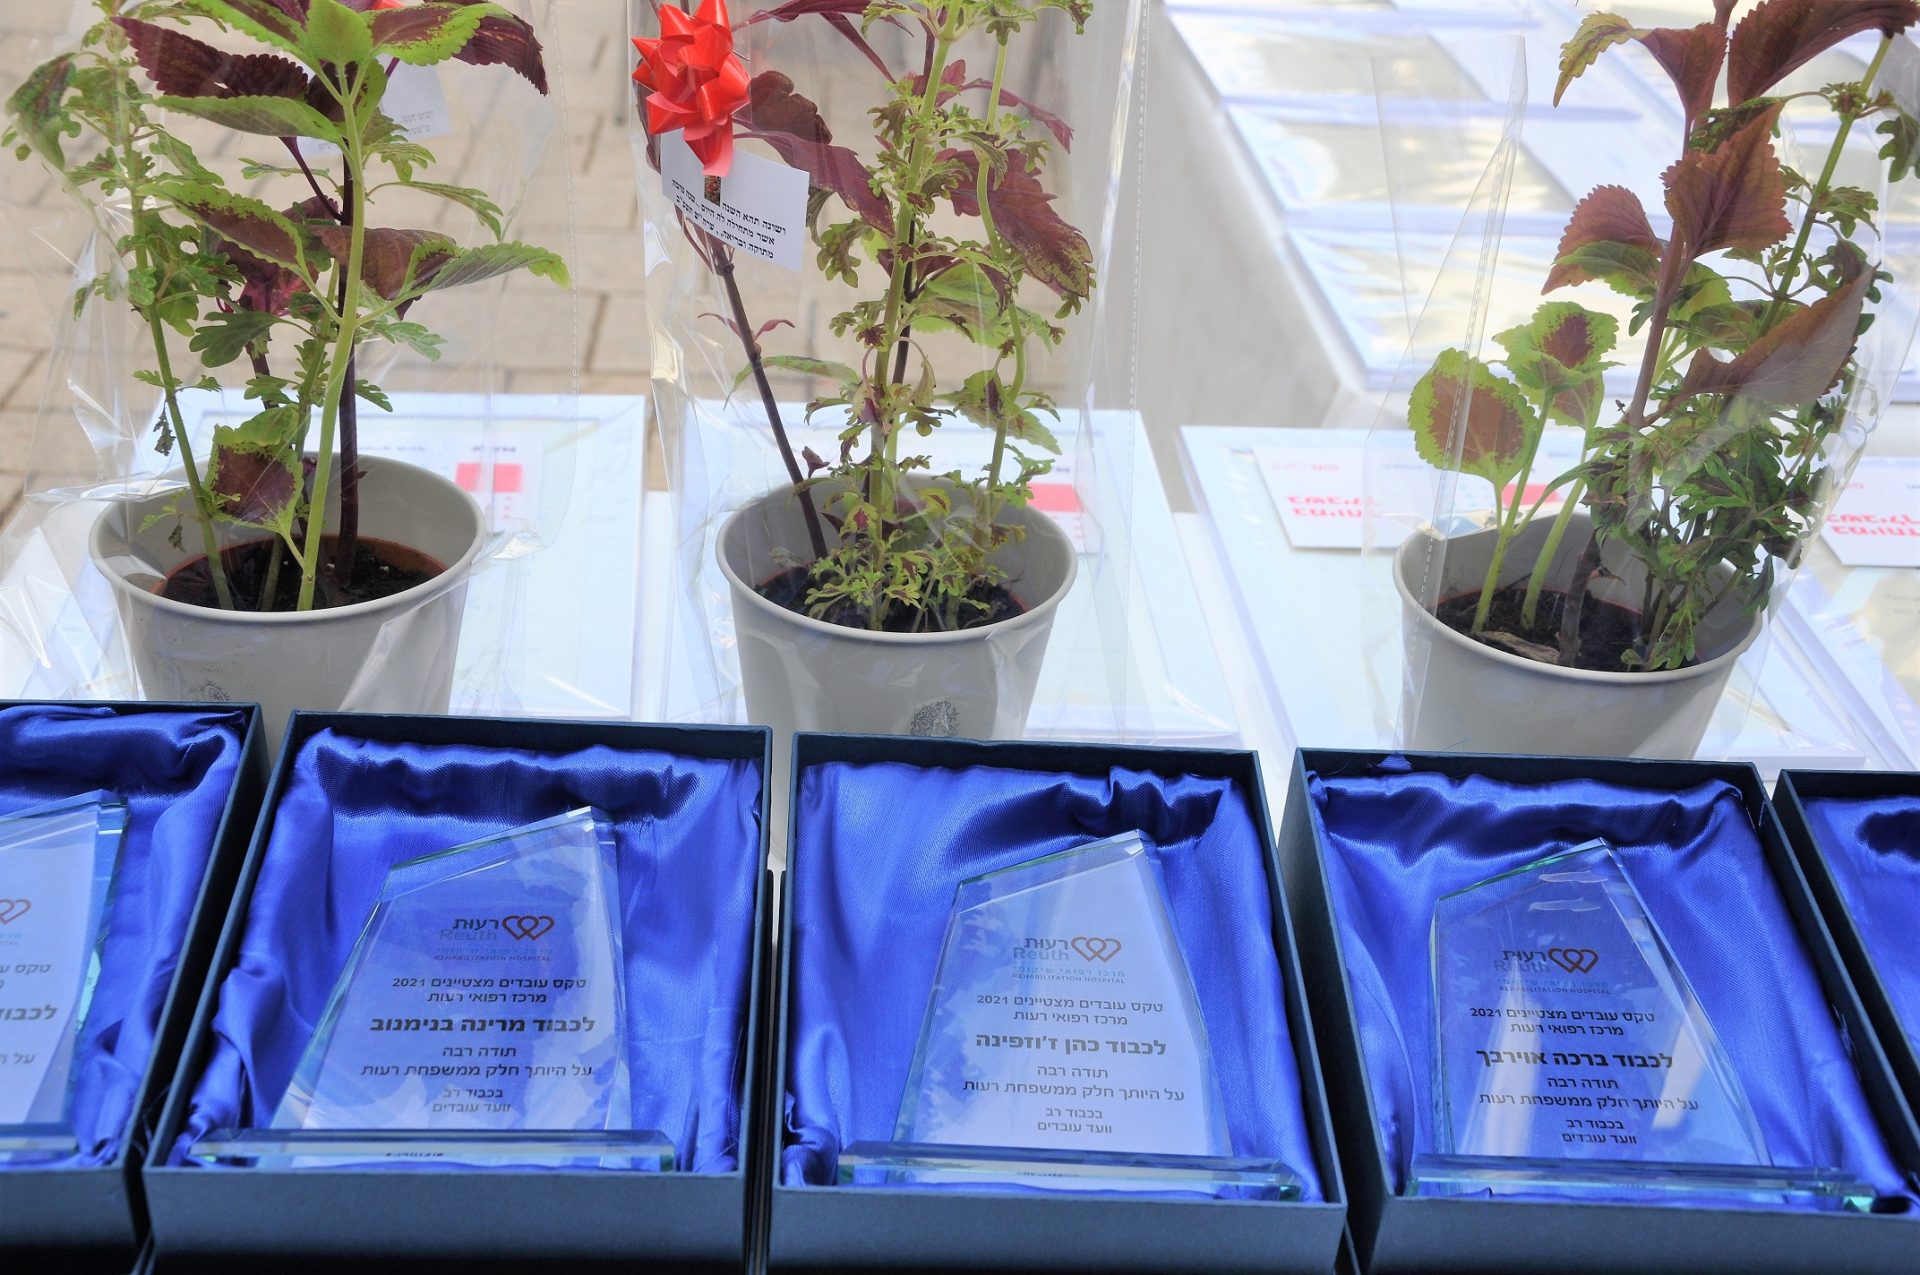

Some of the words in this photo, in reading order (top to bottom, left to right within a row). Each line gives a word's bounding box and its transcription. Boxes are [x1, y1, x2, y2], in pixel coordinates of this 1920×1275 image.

[722, 202, 741, 218] השנה
[716, 212, 725, 223] לה
[742, 213, 760, 226] תהא
[726, 218, 754, 238] מתחילה
[756, 232, 775, 245] אשר
[748, 243, 774, 259] מתוקה
[453, 918, 499, 931] רעות
[1024, 937, 1068, 950] רעות
[1013, 947, 1069, 961] Reuth
[1502, 950, 1547, 963] רעות
[15, 964, 51, 975] טקס
[1494, 959, 1550, 973] Ruth
[392, 978, 425, 987] 2021
[431, 978, 494, 987] מצטיינים
[499, 979, 548, 988] עובדים
[553, 979, 586, 989] טקס
[427, 993, 463, 1002] רעות
[469, 993, 507, 1002] רפואי
[512, 994, 547, 1002] מרכז
[977, 995, 1007, 1004] 2021
[1014, 997, 1074, 1007] מצטיינים
[1080, 1000, 1126, 1010] עובדים
[1131, 1003, 1163, 1013] טקס
[1013, 1012, 1047, 1021] רעות
[1053, 1013, 1088, 1022] רפואי
[1470, 1008, 1501, 1017] 2021
[1506, 1009, 1567, 1019] מצטיינים
[1571, 1011, 1618, 1021] עובדים
[1094, 1016, 1127, 1025] מרכז
[1622, 1013, 1654, 1023] טקס
[370, 1019, 453, 1031] בנימנוב
[461, 1019, 525, 1032] מרינה
[532, 1016, 595, 1032] לכבוד
[1511, 1024, 1546, 1033] רעות
[1548, 1025, 1586, 1034] רפואי
[1589, 1026, 1624, 1035] מרכז
[443, 1047, 472, 1057] רבה
[1065, 1039, 1099, 1055] כהן
[1106, 1040, 1166, 1055] לכבוד
[478, 1048, 516, 1057] תודה
[14, 1052, 36, 1064] על
[1552, 1053, 1609, 1066] ברכה
[1612, 1053, 1672, 1068] לכבוד
[361, 1066, 399, 1075] רעות
[404, 1066, 480, 1076] ממשפחת
[486, 1064, 519, 1078] חלק
[526, 1066, 566, 1078] היותך
[572, 1065, 592, 1076] על
[1037, 1066, 1066, 1076] רבה
[1072, 1068, 1108, 1078] תודה
[963, 1081, 998, 1091] רעות
[1547, 1078, 1577, 1087] רבה
[1581, 1079, 1619, 1089] תודה
[443, 1089, 463, 1098] רב
[466, 1089, 503, 1098] בכבוד
[1004, 1083, 1076, 1095] ממשפחת
[1082, 1085, 1114, 1098] חלק
[1119, 1089, 1159, 1100] היותך
[1164, 1089, 1184, 1101] על
[1479, 1094, 1515, 1104] רעות
[1521, 1096, 1592, 1106] ממשפחת
[1596, 1096, 1629, 1109] חלק
[1632, 1099, 1674, 1111] היותך
[1677, 1098, 1699, 1110] על
[432, 1103, 479, 1112] עובדים
[484, 1103, 511, 1112] וועד
[1046, 1108, 1061, 1116] רב
[1066, 1109, 1103, 1119] בכבוד
[1038, 1122, 1081, 1132] עובדים
[1086, 1124, 1111, 1133] וועד
[1566, 1120, 1582, 1128] רב
[1588, 1120, 1624, 1129] בכבוד
[1562, 1133, 1606, 1143] עובדים
[1610, 1135, 1637, 1144] וועד
